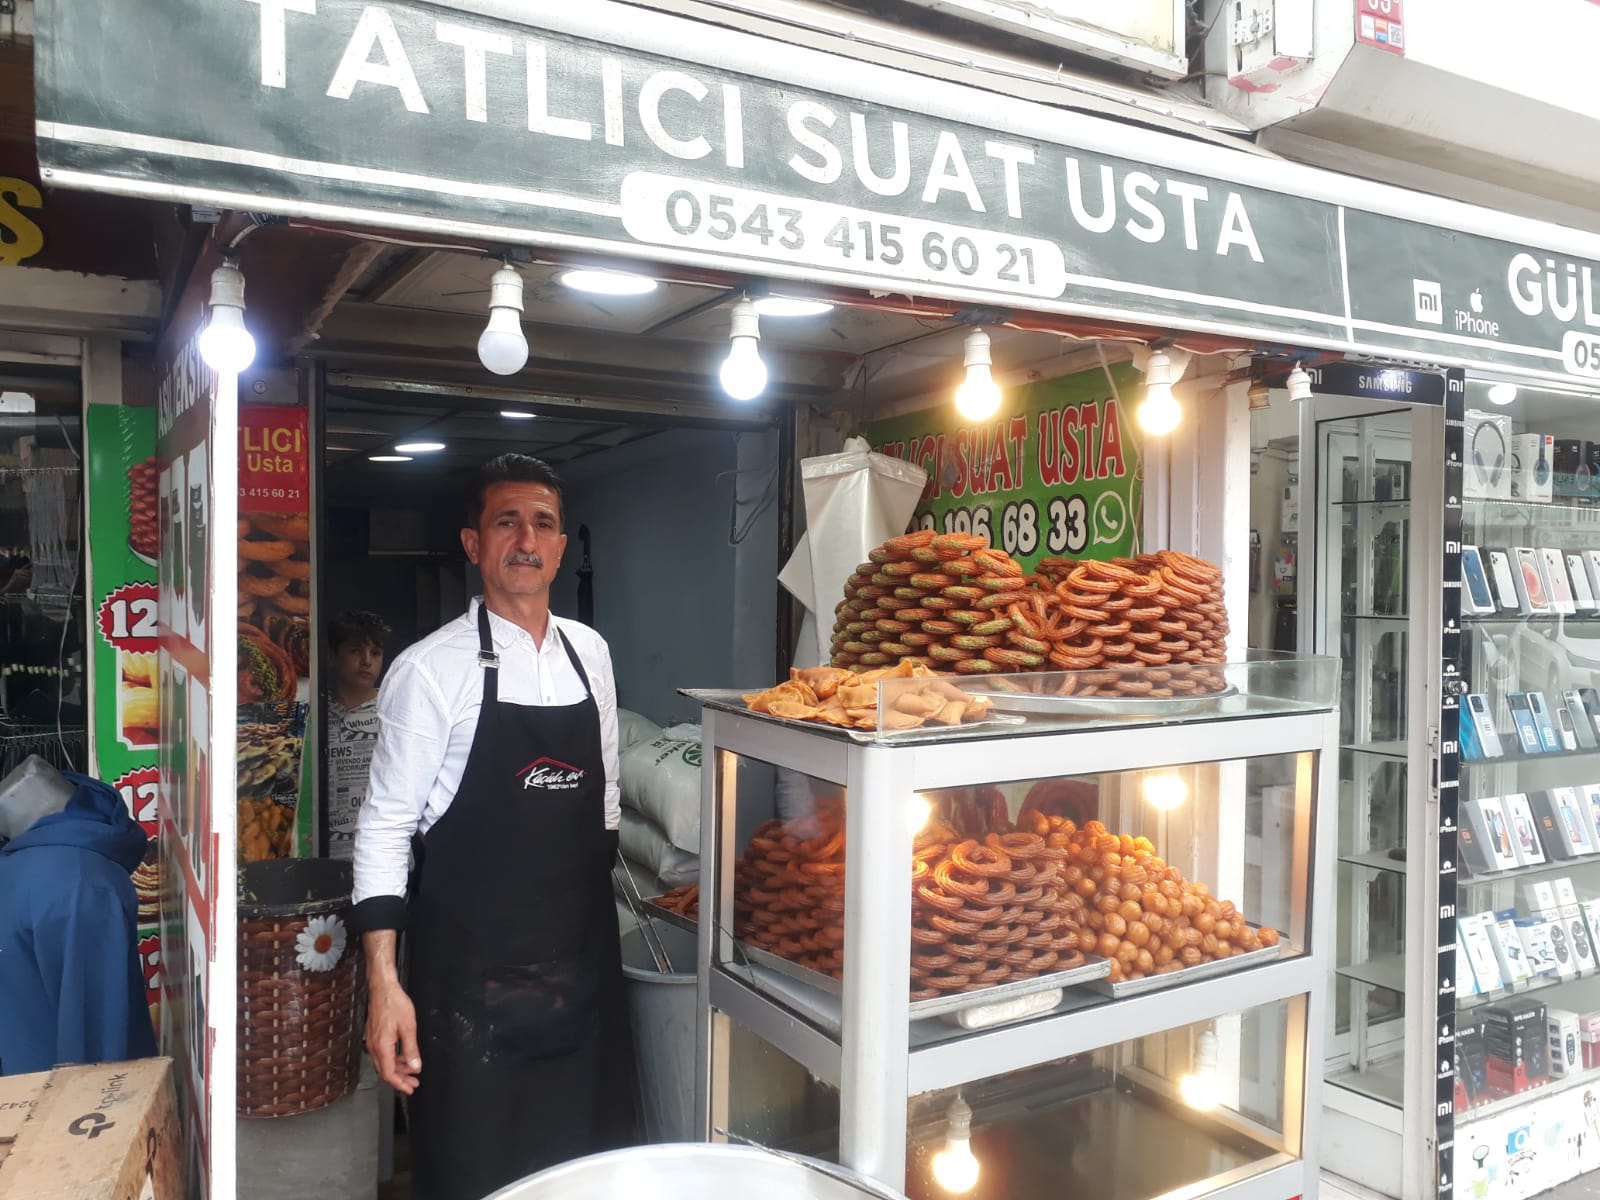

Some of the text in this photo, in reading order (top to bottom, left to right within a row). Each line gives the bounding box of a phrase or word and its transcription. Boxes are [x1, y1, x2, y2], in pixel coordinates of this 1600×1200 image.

[254, 0, 1264, 263] TATLICI SUAT USTA
[665, 189, 1036, 285] 0543 415 60 21
[1455, 309, 1500, 337] iPhone
[1358, 374, 1413, 395] SAMSUNG
[240, 426, 302, 453] LICI
[951, 414, 1028, 499] SUAT
[1038, 399, 1127, 488] USTA
[247, 453, 294, 473] Usta
[249, 488, 270, 498] 415
[271, 488, 286, 499] 60
[287, 489, 301, 499] 21
[1001, 499, 1040, 557] 68
[1048, 493, 1089, 556] 33
[330, 746, 353, 759] EWS
